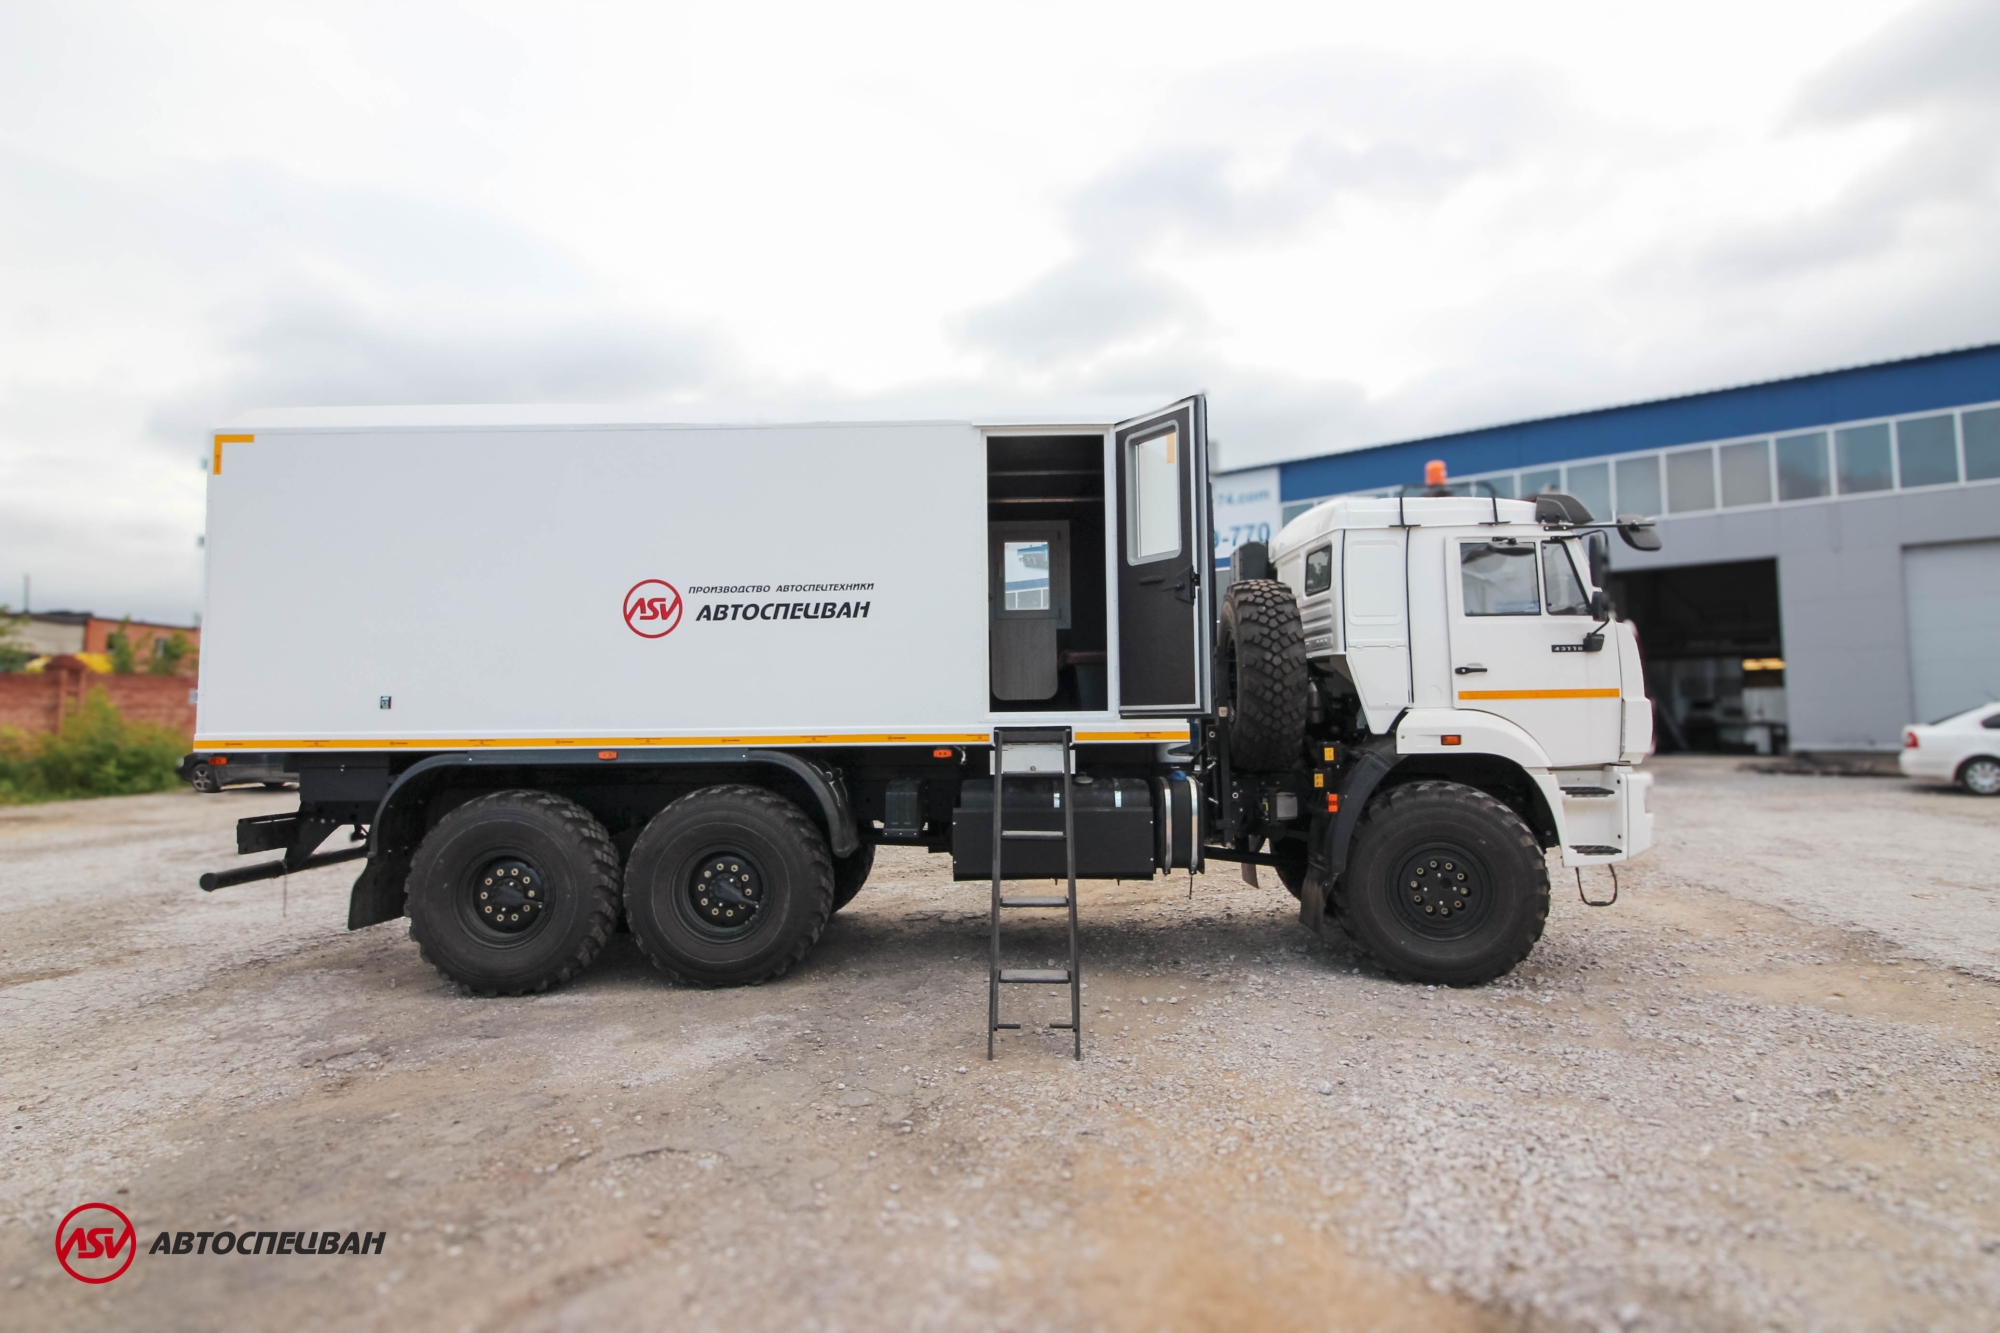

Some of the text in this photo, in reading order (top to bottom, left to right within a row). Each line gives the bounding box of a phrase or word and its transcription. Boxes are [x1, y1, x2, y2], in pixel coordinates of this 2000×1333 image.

[688, 582, 875, 594] ПРОИЗВОДСТВО АВТОСПЕЦТЕХНИКИ
[695, 601, 871, 622] АВТОСПЕЦВАН
